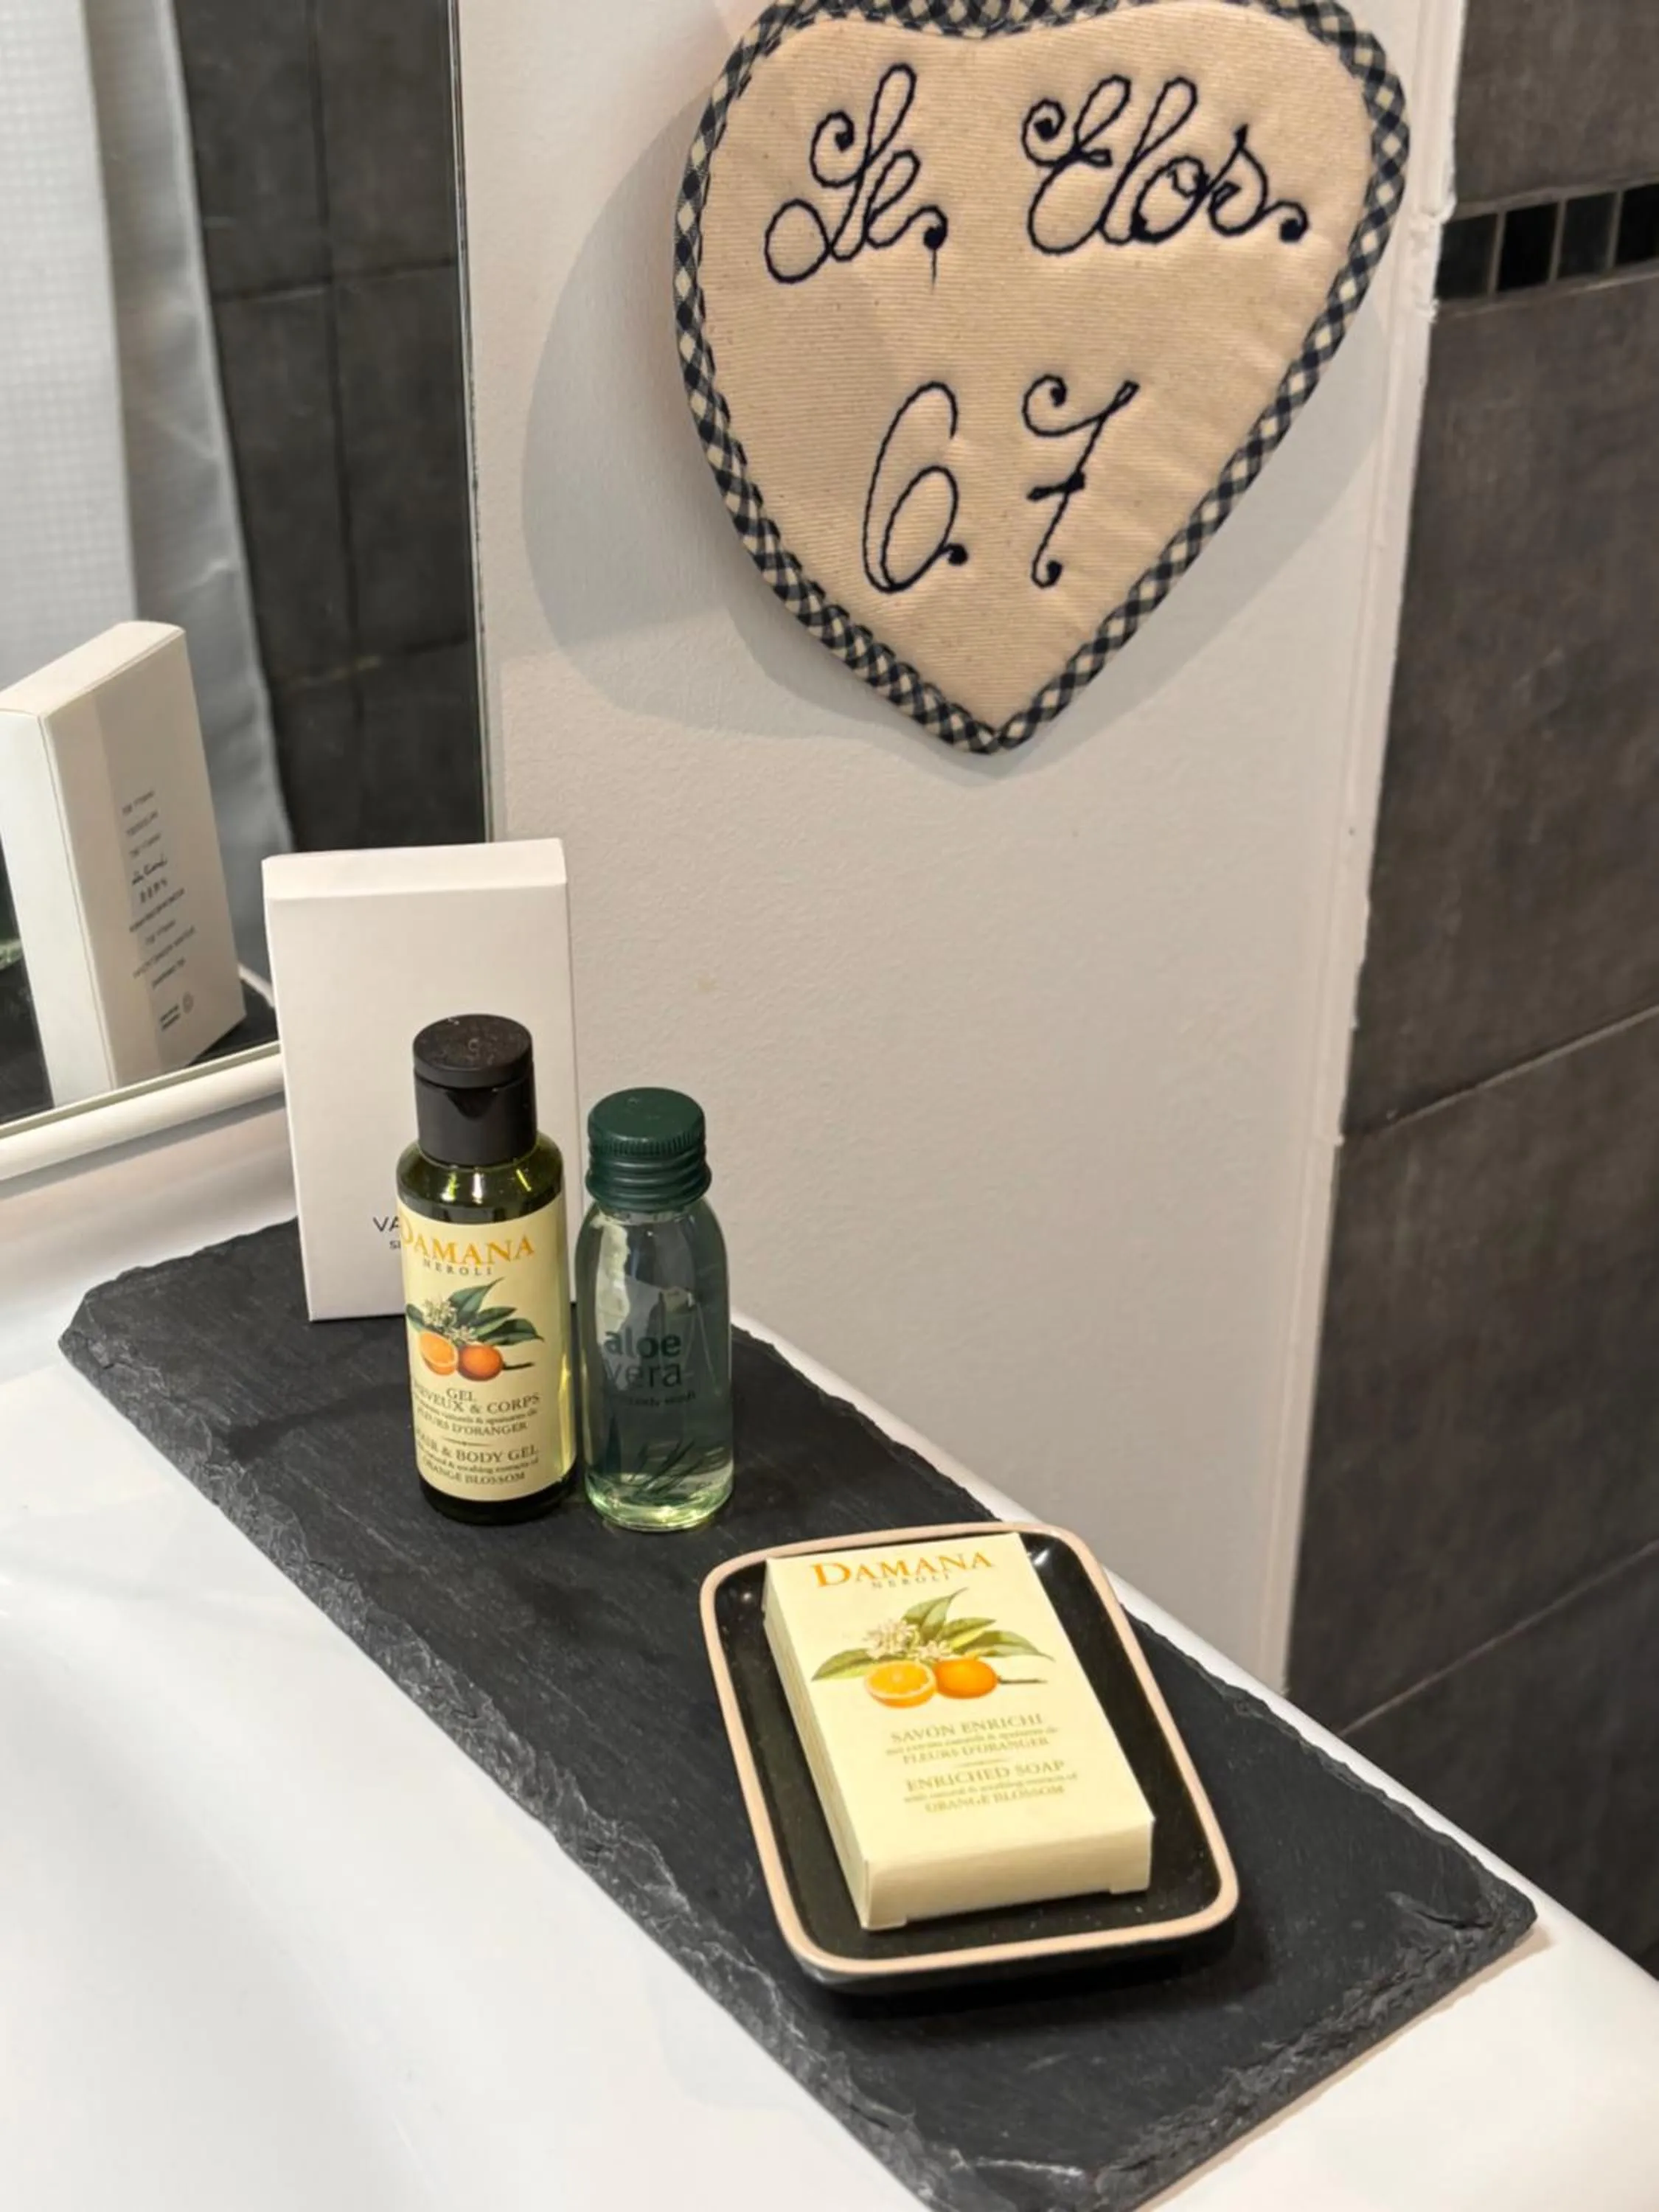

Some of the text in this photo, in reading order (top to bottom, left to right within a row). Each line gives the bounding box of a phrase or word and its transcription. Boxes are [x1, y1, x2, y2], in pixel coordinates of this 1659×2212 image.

[423, 1259, 492, 1276] NEROLI
[604, 1326, 681, 1358] aloe
[604, 1359, 681, 1388] vera
[446, 1388, 474, 1401] GEL
[487, 1392, 540, 1413] CORPS
[456, 1450, 504, 1464] BODY
[507, 1445, 539, 1461] GEL
[810, 1551, 995, 1587] DAMANA
[872, 1573, 951, 1589] NEROLI
[890, 1723, 956, 1742] SAVON
[961, 1714, 1043, 1733] ENRICHI
[906, 1766, 1011, 1792] ENRICHED
[1015, 1760, 1065, 1775] SOAP
